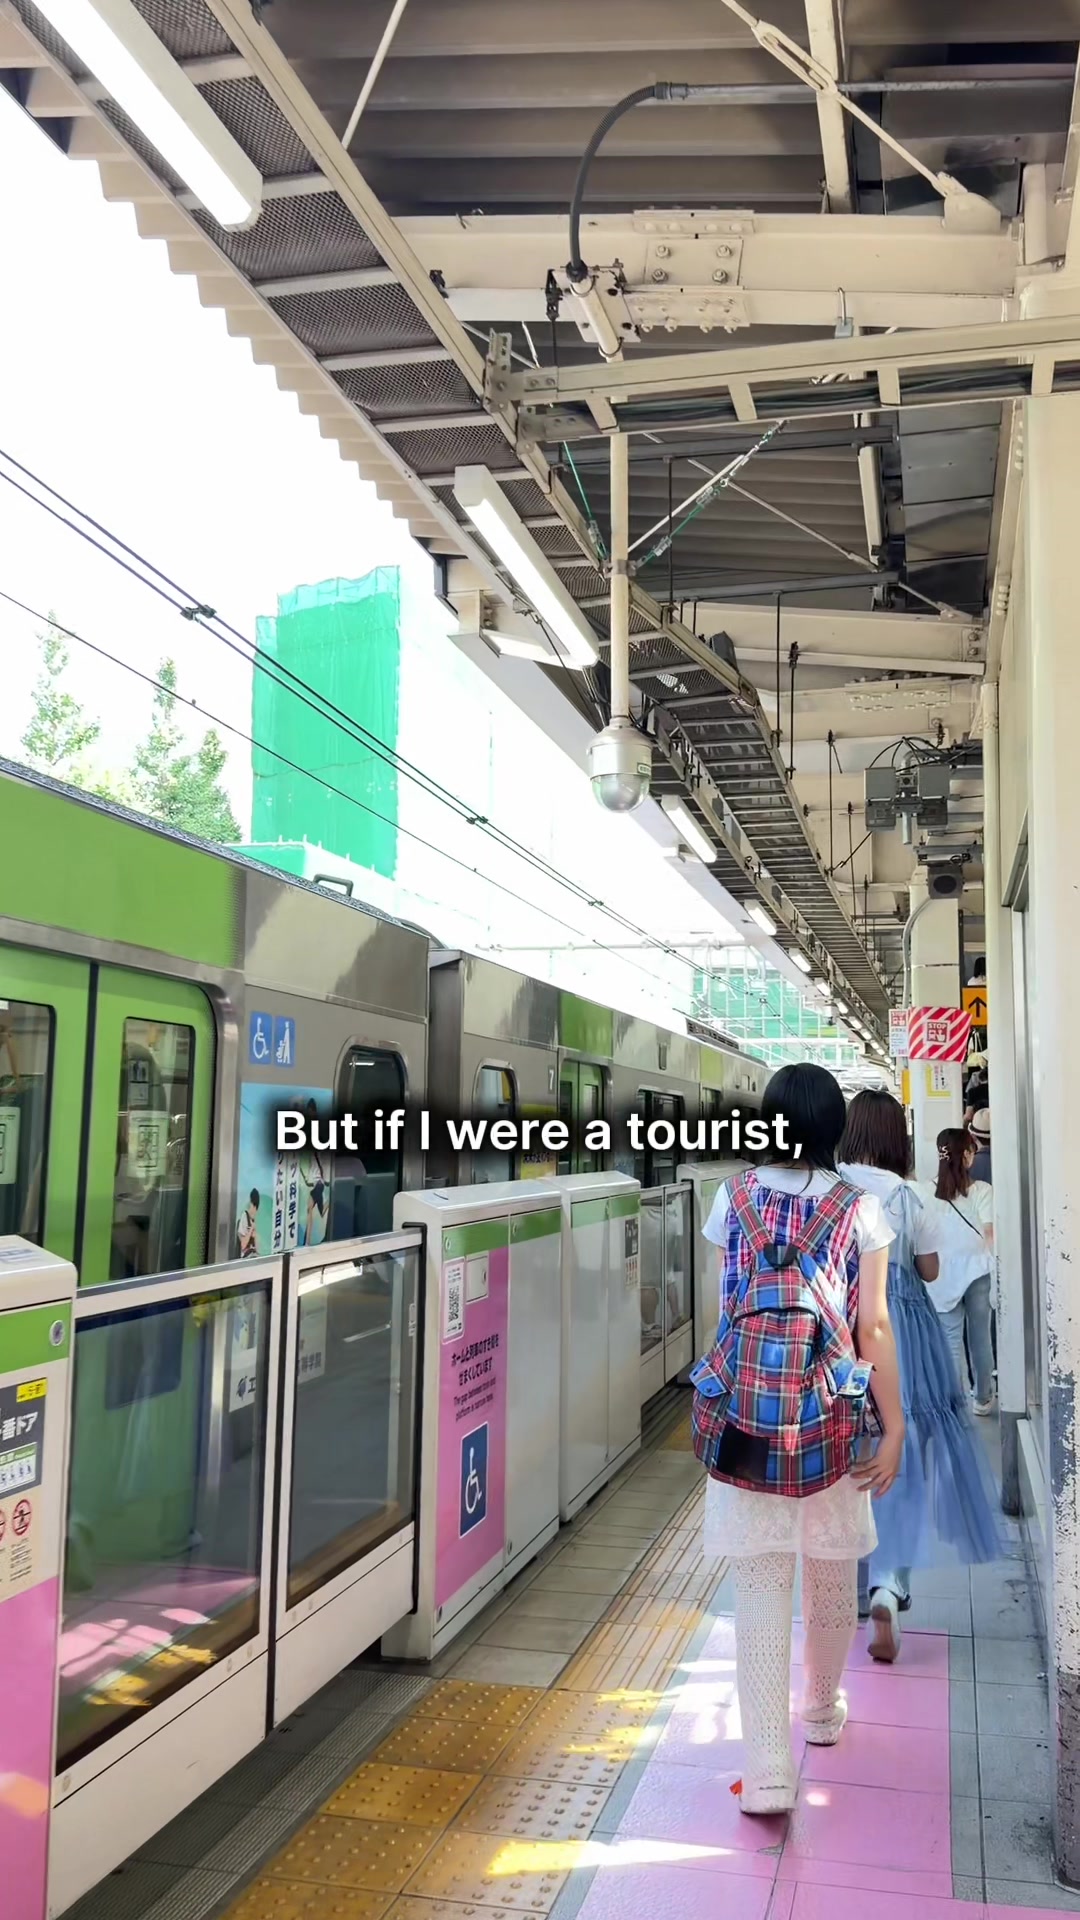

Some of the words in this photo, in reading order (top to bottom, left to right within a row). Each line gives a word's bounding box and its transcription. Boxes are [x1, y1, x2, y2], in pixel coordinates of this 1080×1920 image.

[549, 1068, 555, 1091] 7
[0, 1411, 38, 1441] 番ドア
